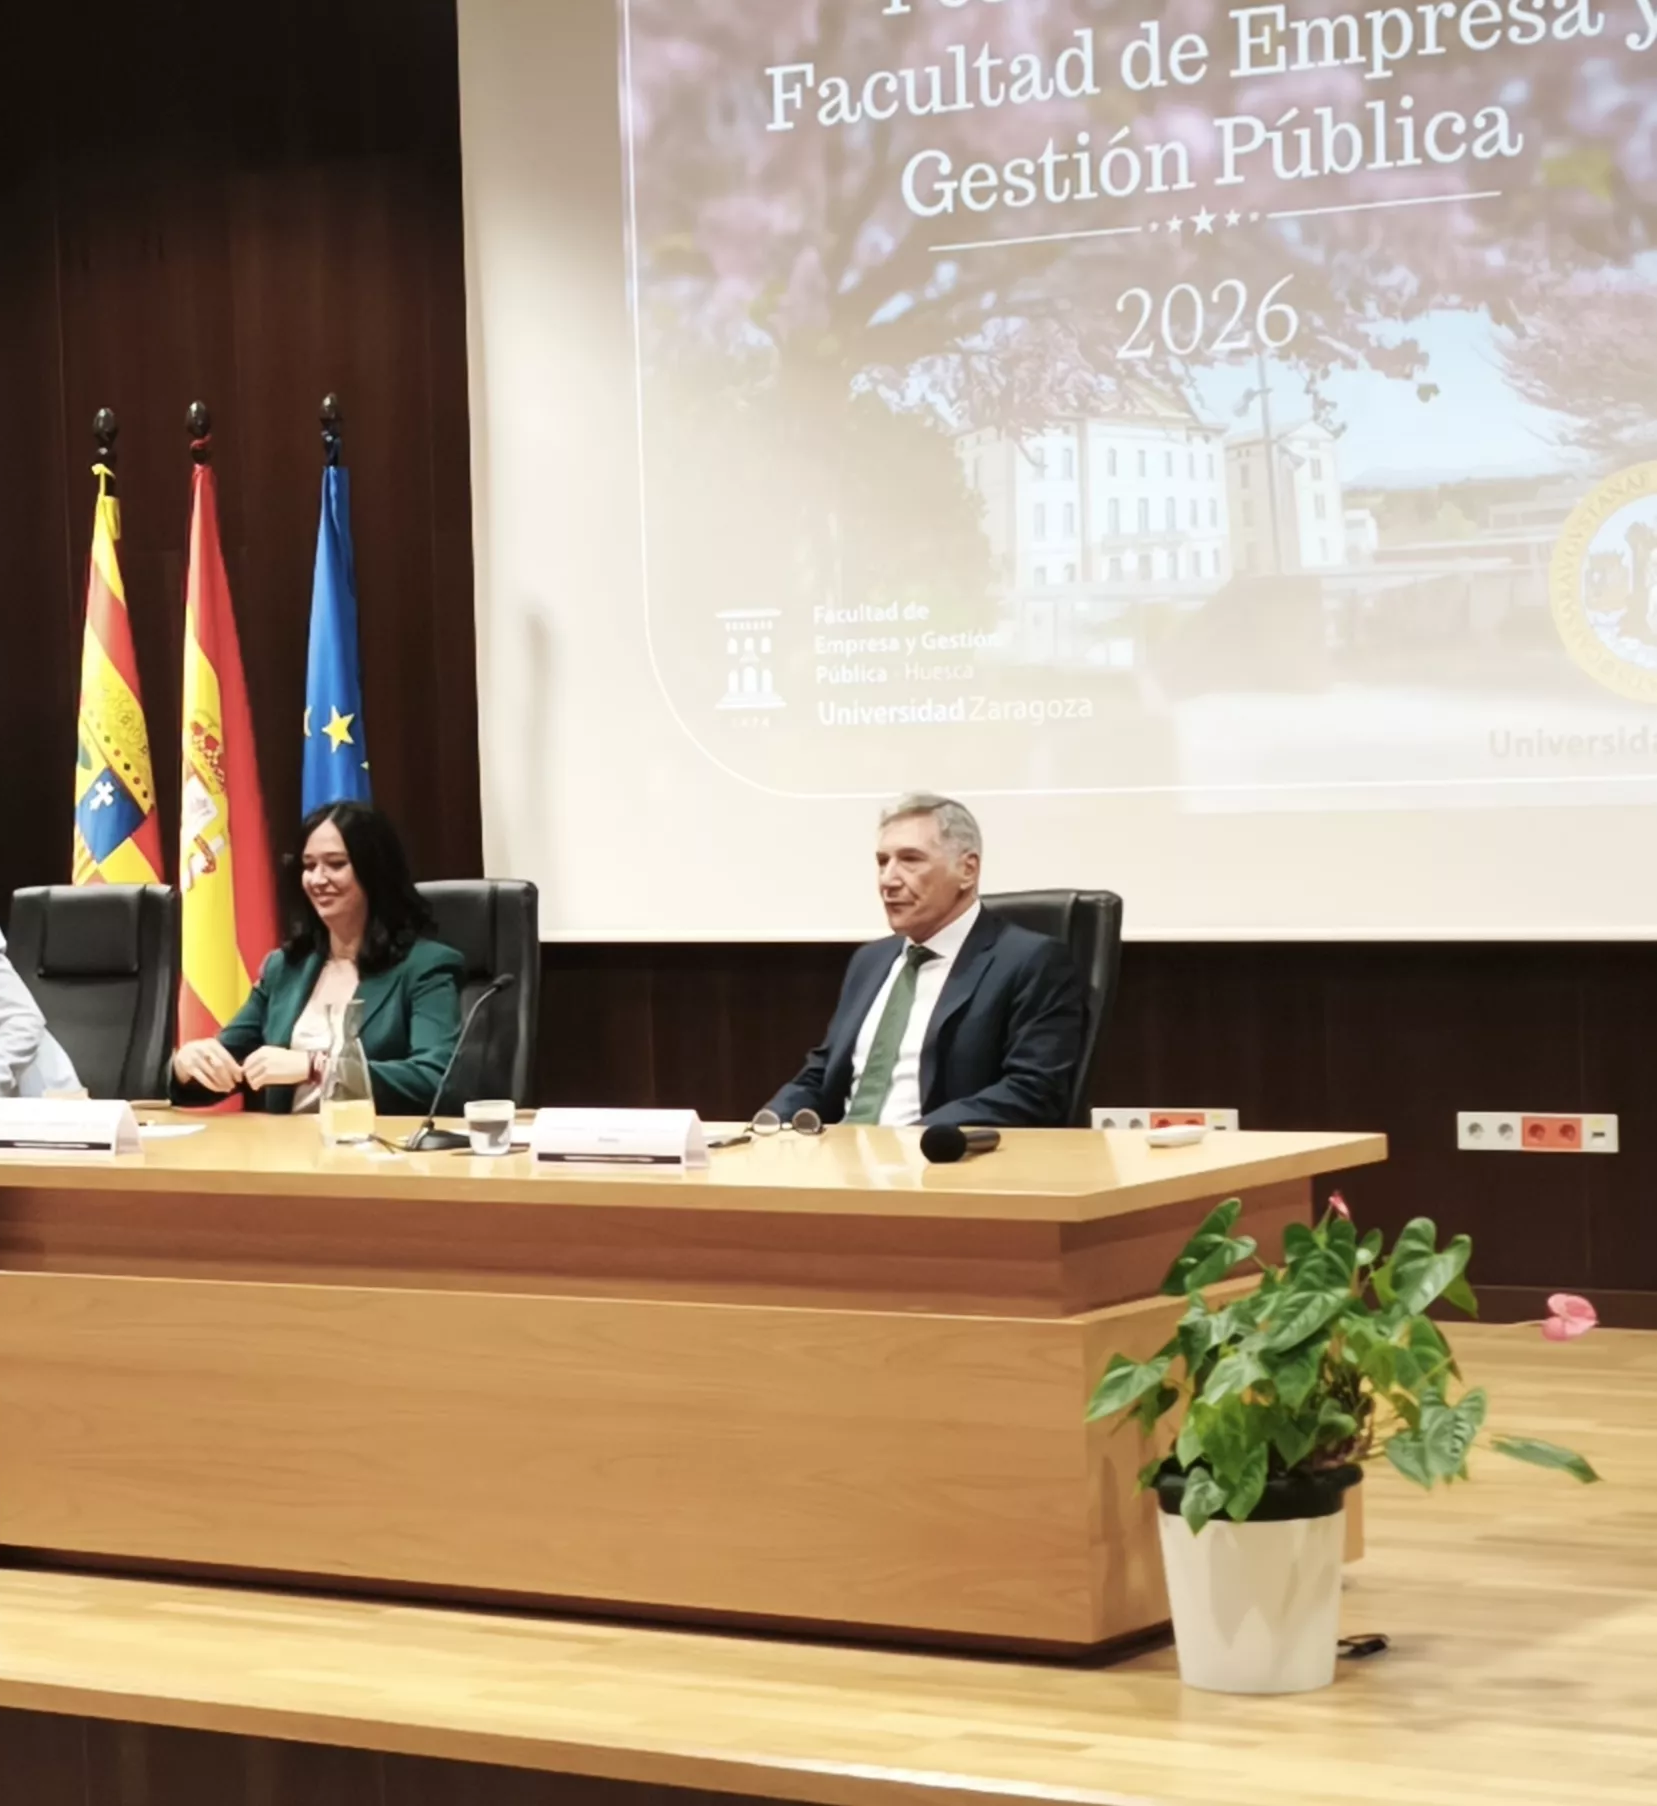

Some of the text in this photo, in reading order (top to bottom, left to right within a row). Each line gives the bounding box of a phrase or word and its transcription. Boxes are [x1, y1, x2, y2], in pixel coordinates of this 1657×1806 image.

[764, 30, 1100, 132] Facultad
[1120, 22, 1210, 92] de
[1228, 0, 1606, 80] Empresa
[901, 94, 1524, 216] Gestión Pública
[1114, 273, 1300, 361] 2026
[812, 600, 930, 626] Facultad de
[814, 634, 900, 659] Empresa
[903, 636, 917, 656] y
[815, 662, 888, 685] Pública
[817, 695, 1094, 727] Universidad Zaragoza
[1488, 723, 1657, 759] Universid
